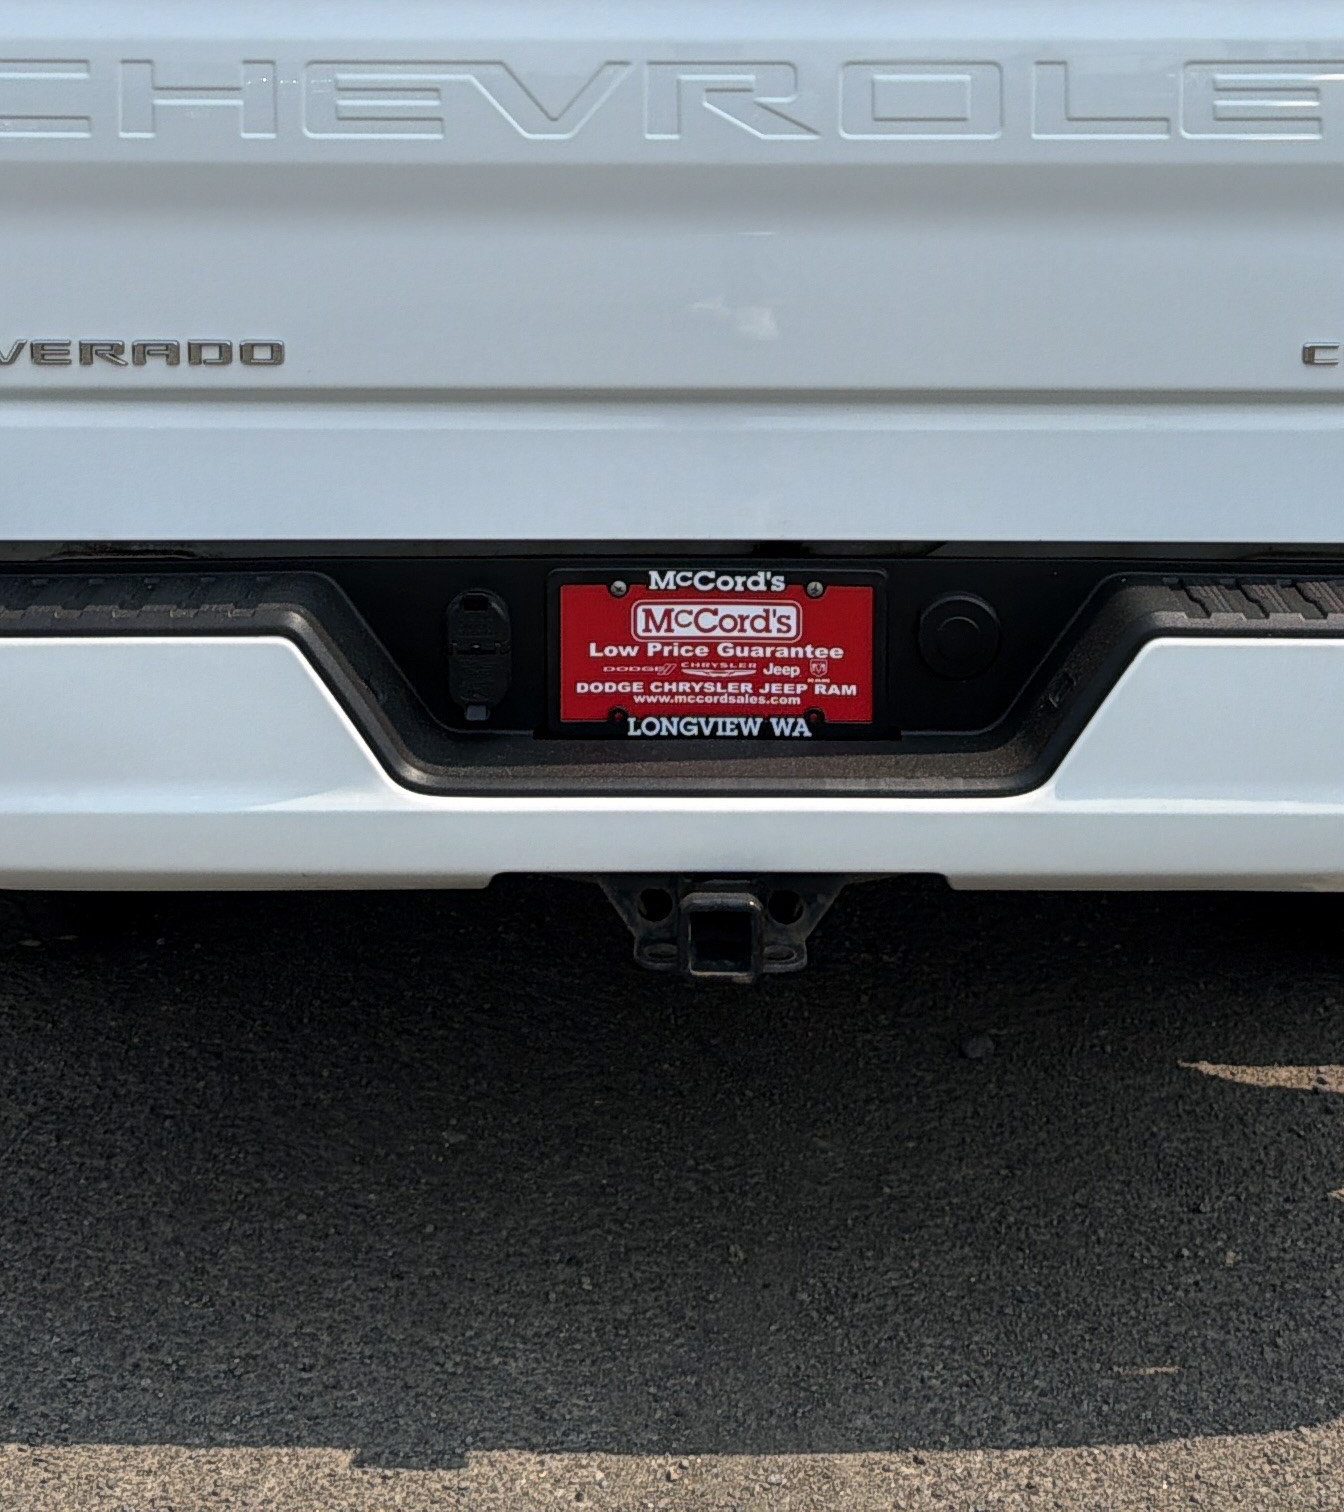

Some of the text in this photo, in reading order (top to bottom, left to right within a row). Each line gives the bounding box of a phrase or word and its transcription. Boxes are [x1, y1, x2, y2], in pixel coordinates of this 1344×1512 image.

[648, 570, 786, 592] McCord's
[642, 607, 793, 635] McCord's
[589, 642, 844, 659] Low Price Guarantee
[602, 665, 664, 673] DODGE
[680, 661, 757, 669] CHRYSLER
[763, 662, 801, 678] Jeep
[576, 681, 857, 696] DODGE CHRYSLER JEEP RAM
[633, 693, 801, 705] www.mccordsales.com
[627, 716, 812, 737] LONGVIEW WA
